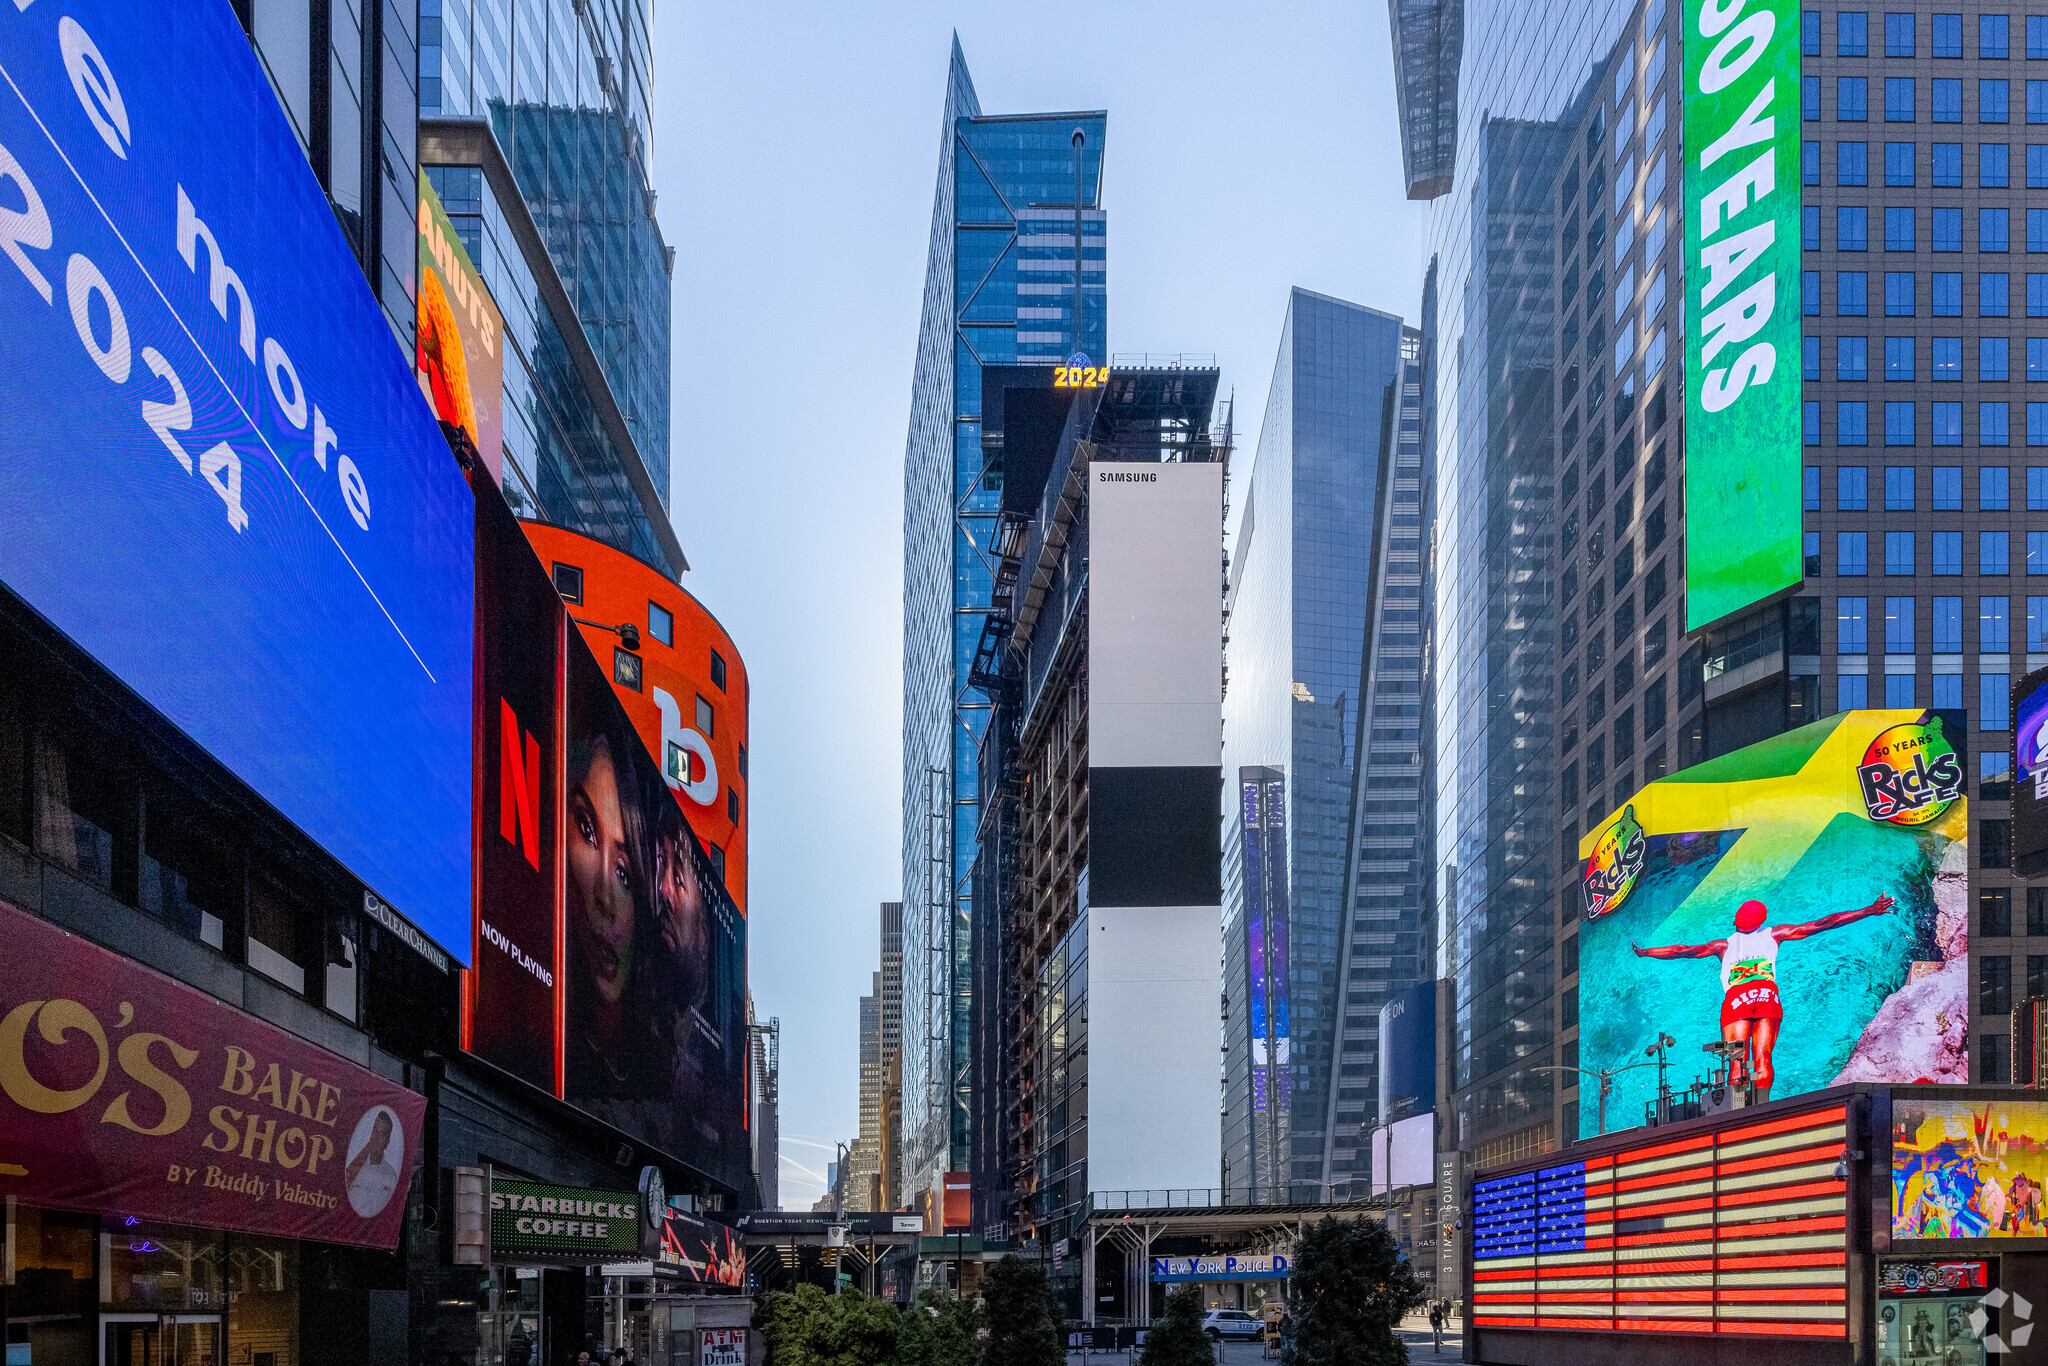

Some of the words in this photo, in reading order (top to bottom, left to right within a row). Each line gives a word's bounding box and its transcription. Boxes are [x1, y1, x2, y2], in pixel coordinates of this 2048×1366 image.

[1700, 77, 1777, 414] YEARS
[0, 143, 249, 534] 2024
[177, 182, 371, 531] more
[1054, 366, 1109, 388] 2024
[1099, 472, 1157, 482] SAMSUNG
[1875, 746, 1890, 758] 50
[1893, 734, 1933, 752] YEARS
[1922, 802, 1947, 821] JAMAICA
[1591, 855, 1600, 869] 50
[1601, 825, 1627, 856] YEARS
[481, 919, 509, 953] NOW
[510, 943, 553, 987] PLAYING
[219, 1045, 342, 1128] BAKE
[202, 1105, 334, 1176] SHOP
[167, 1164, 198, 1185] BY
[204, 1165, 270, 1202] Buddy
[274, 1180, 338, 1211] Valastro
[1443, 1161, 1453, 1211] SQUARE
[491, 1193, 637, 1220] STARBUCKS
[516, 1218, 609, 1239] COFFEE
[1416, 1240, 1438, 1248] CHAS
[703, 1328, 745, 1346] ATM
[704, 1351, 743, 1366] Drink
